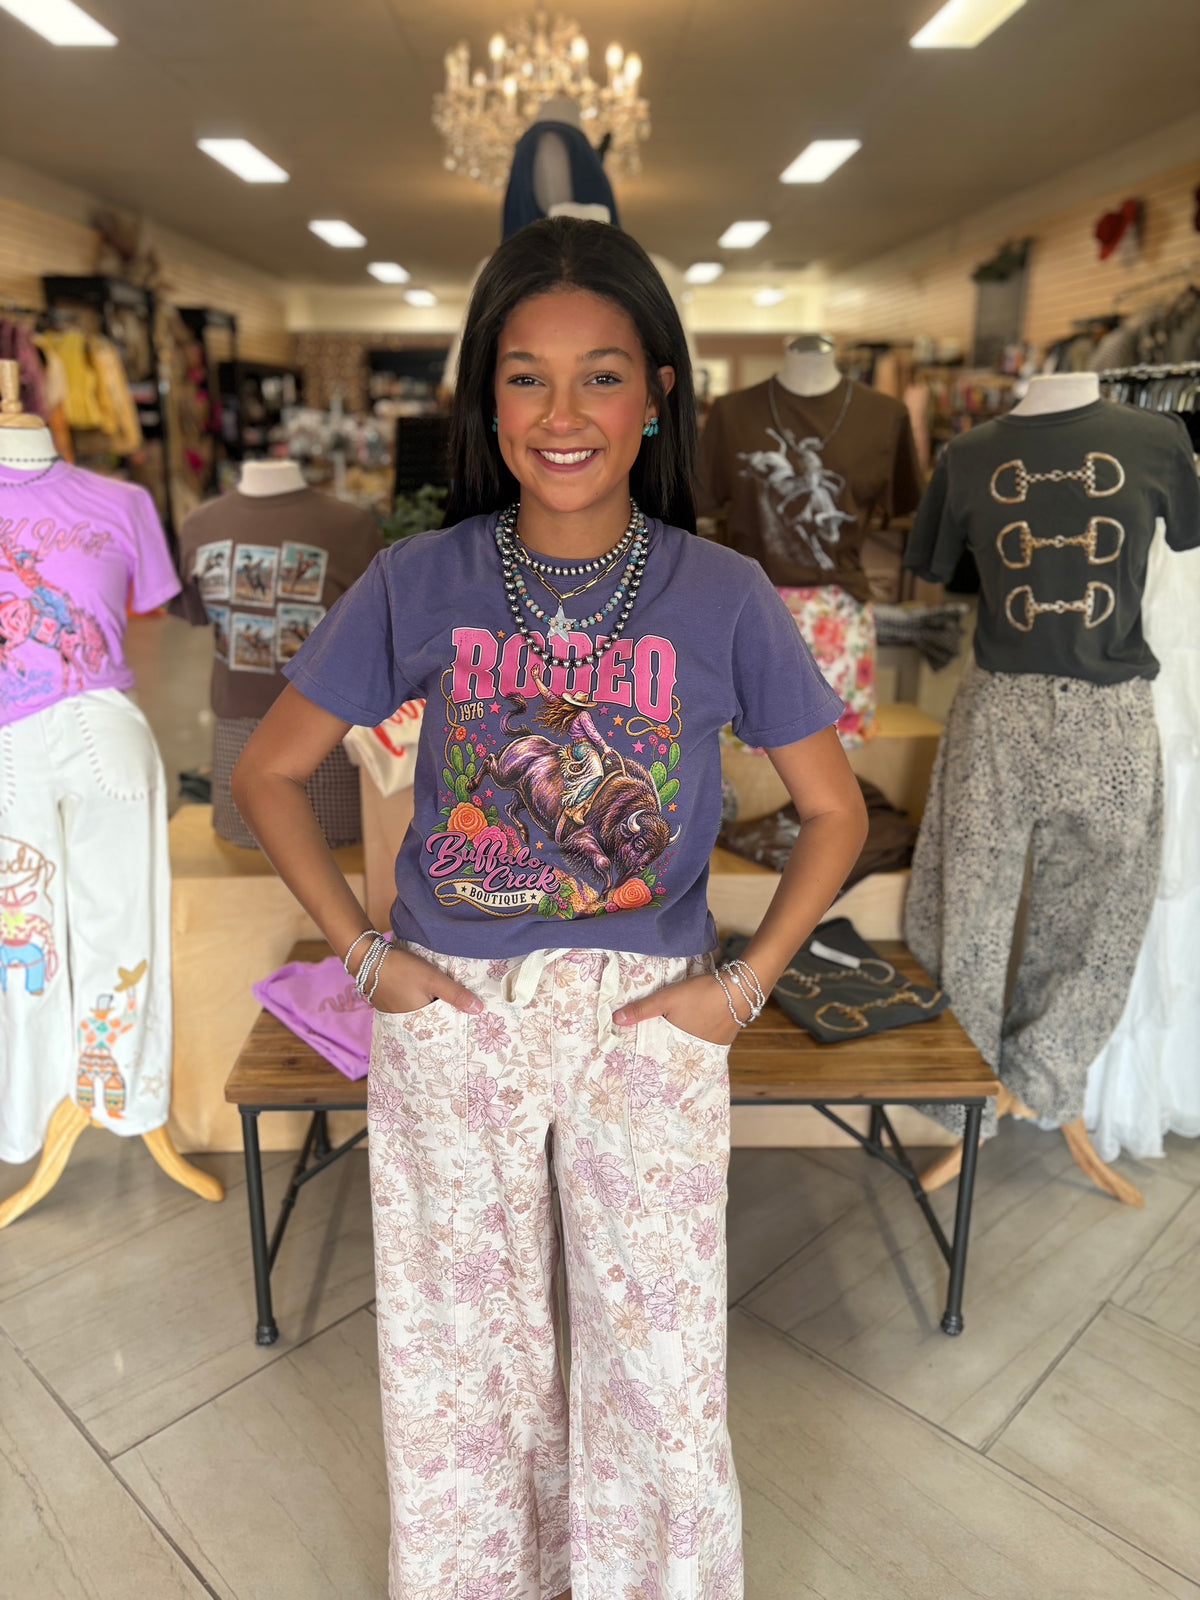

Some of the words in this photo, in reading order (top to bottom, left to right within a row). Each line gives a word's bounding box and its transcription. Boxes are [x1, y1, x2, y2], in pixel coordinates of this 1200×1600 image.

[450, 626, 678, 723] RODEO
[459, 701, 484, 722] 1976
[425, 831, 546, 878] Buffalo
[482, 864, 561, 893] Creek
[469, 886, 527, 905] BOUTIQUE
